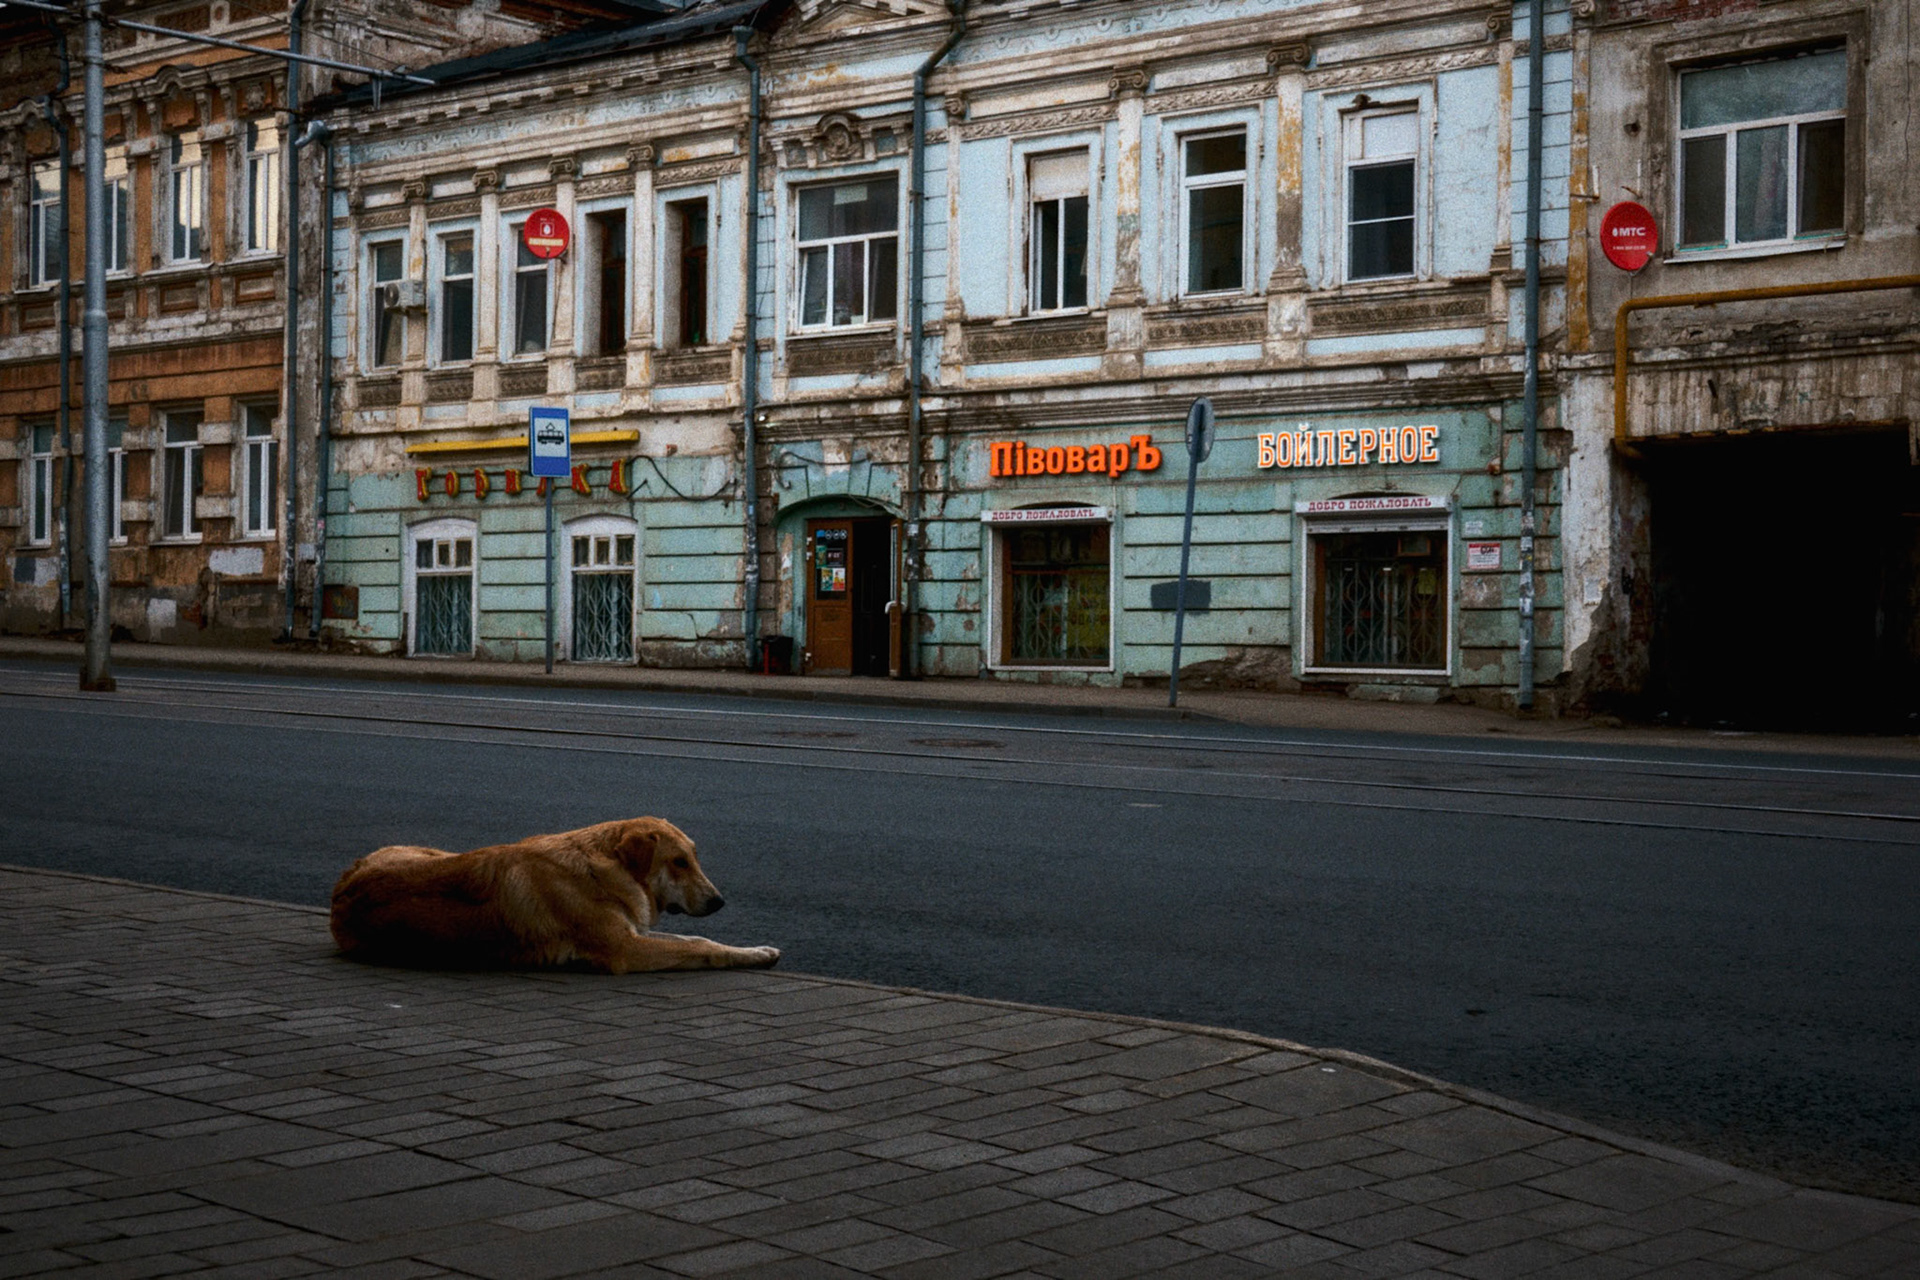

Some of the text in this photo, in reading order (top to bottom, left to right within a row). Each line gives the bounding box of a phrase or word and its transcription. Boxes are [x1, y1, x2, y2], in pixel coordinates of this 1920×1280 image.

[1619, 227, 1646, 237] МТС
[1258, 422, 1440, 469] БОЙЛЕРНОЕ
[1308, 498, 1432, 511] ДОБРО ПОЖАЛОВАТЬ
[992, 509, 1095, 520] ДОБРО ПОЖАЛОВАТЬ
